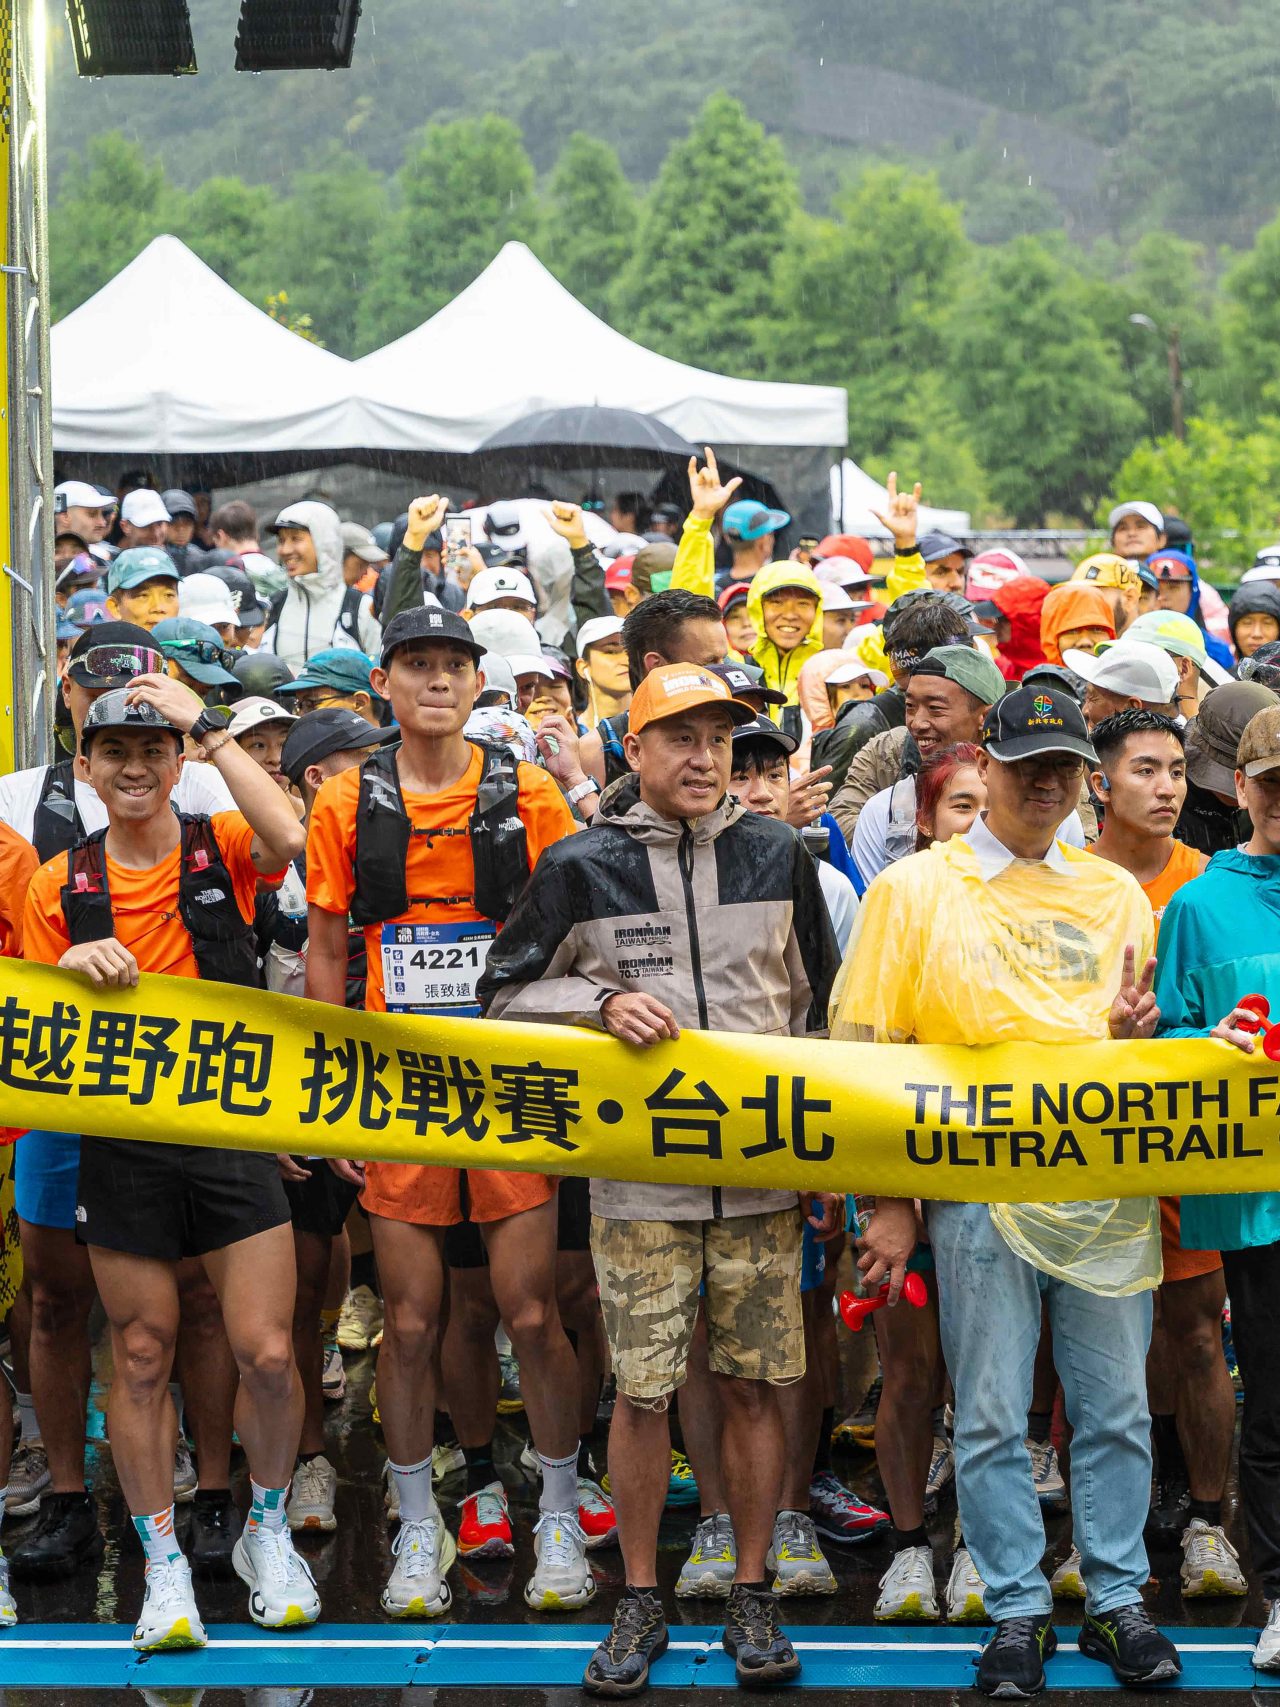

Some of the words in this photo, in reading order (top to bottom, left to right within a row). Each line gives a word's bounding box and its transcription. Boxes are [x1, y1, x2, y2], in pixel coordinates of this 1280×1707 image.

[614, 922, 671, 939] IRONMAN
[615, 937, 647, 946] TAIWAN
[410, 946, 479, 970] 4221
[617, 952, 673, 970] IRONMAN
[619, 969, 640, 979] 70.3
[424, 982, 471, 999] 張致遠
[0, 995, 275, 1117] 越野跑
[904, 1082, 1015, 1126] THE
[1032, 1079, 1229, 1126] NORTH
[905, 1129, 1089, 1168] ULTRA
[1100, 1122, 1264, 1165] TRAIL
